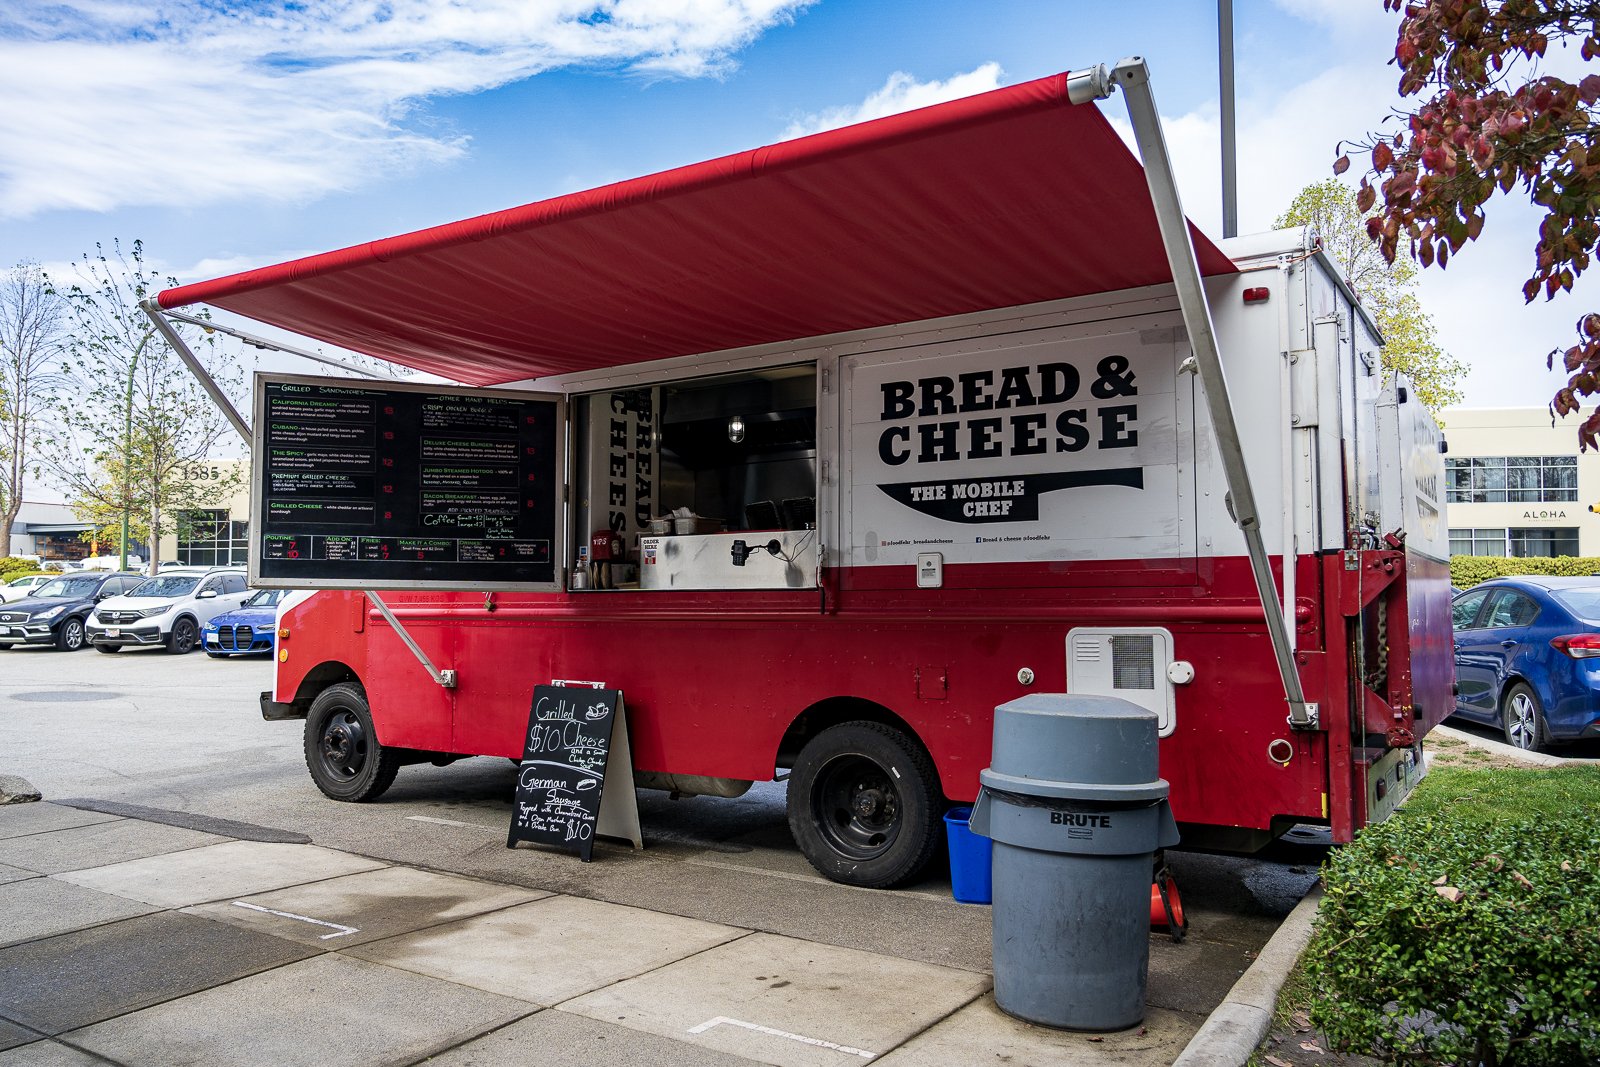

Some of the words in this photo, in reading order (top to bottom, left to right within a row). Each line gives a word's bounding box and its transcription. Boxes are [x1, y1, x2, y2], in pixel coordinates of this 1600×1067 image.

[281, 384, 311, 392] GRILLED
[319, 387, 365, 395] SANDWICHES
[881, 361, 1080, 421] BREAD
[1090, 355, 1138, 400] &
[878, 404, 1138, 466] CHEESE
[635, 393, 652, 528] BREAD
[609, 392, 627, 560] CHEES
[383, 485, 393, 493] 12
[910, 485, 946, 502] THE
[952, 480, 1025, 499] MOBILE
[383, 511, 392, 520] 8
[963, 500, 1013, 518] CHEF
[1523, 510, 1567, 519] ALOHA
[423, 514, 456, 526] Coffee
[289, 541, 297, 549] 7
[593, 537, 608, 546] TIPS
[287, 550, 299, 559] 10
[382, 551, 390, 560] 7
[417, 551, 425, 560] 5
[499, 546, 505, 557] 2
[536, 697, 576, 721] Grilled
[527, 724, 560, 753] $10
[563, 721, 606, 749] Cheese
[520, 767, 567, 792] German
[545, 789, 581, 811] Sausage
[520, 801, 538, 817] Topped
[541, 804, 552, 813] with
[1051, 811, 1112, 828] BRUTE
[565, 818, 592, 842] $10
